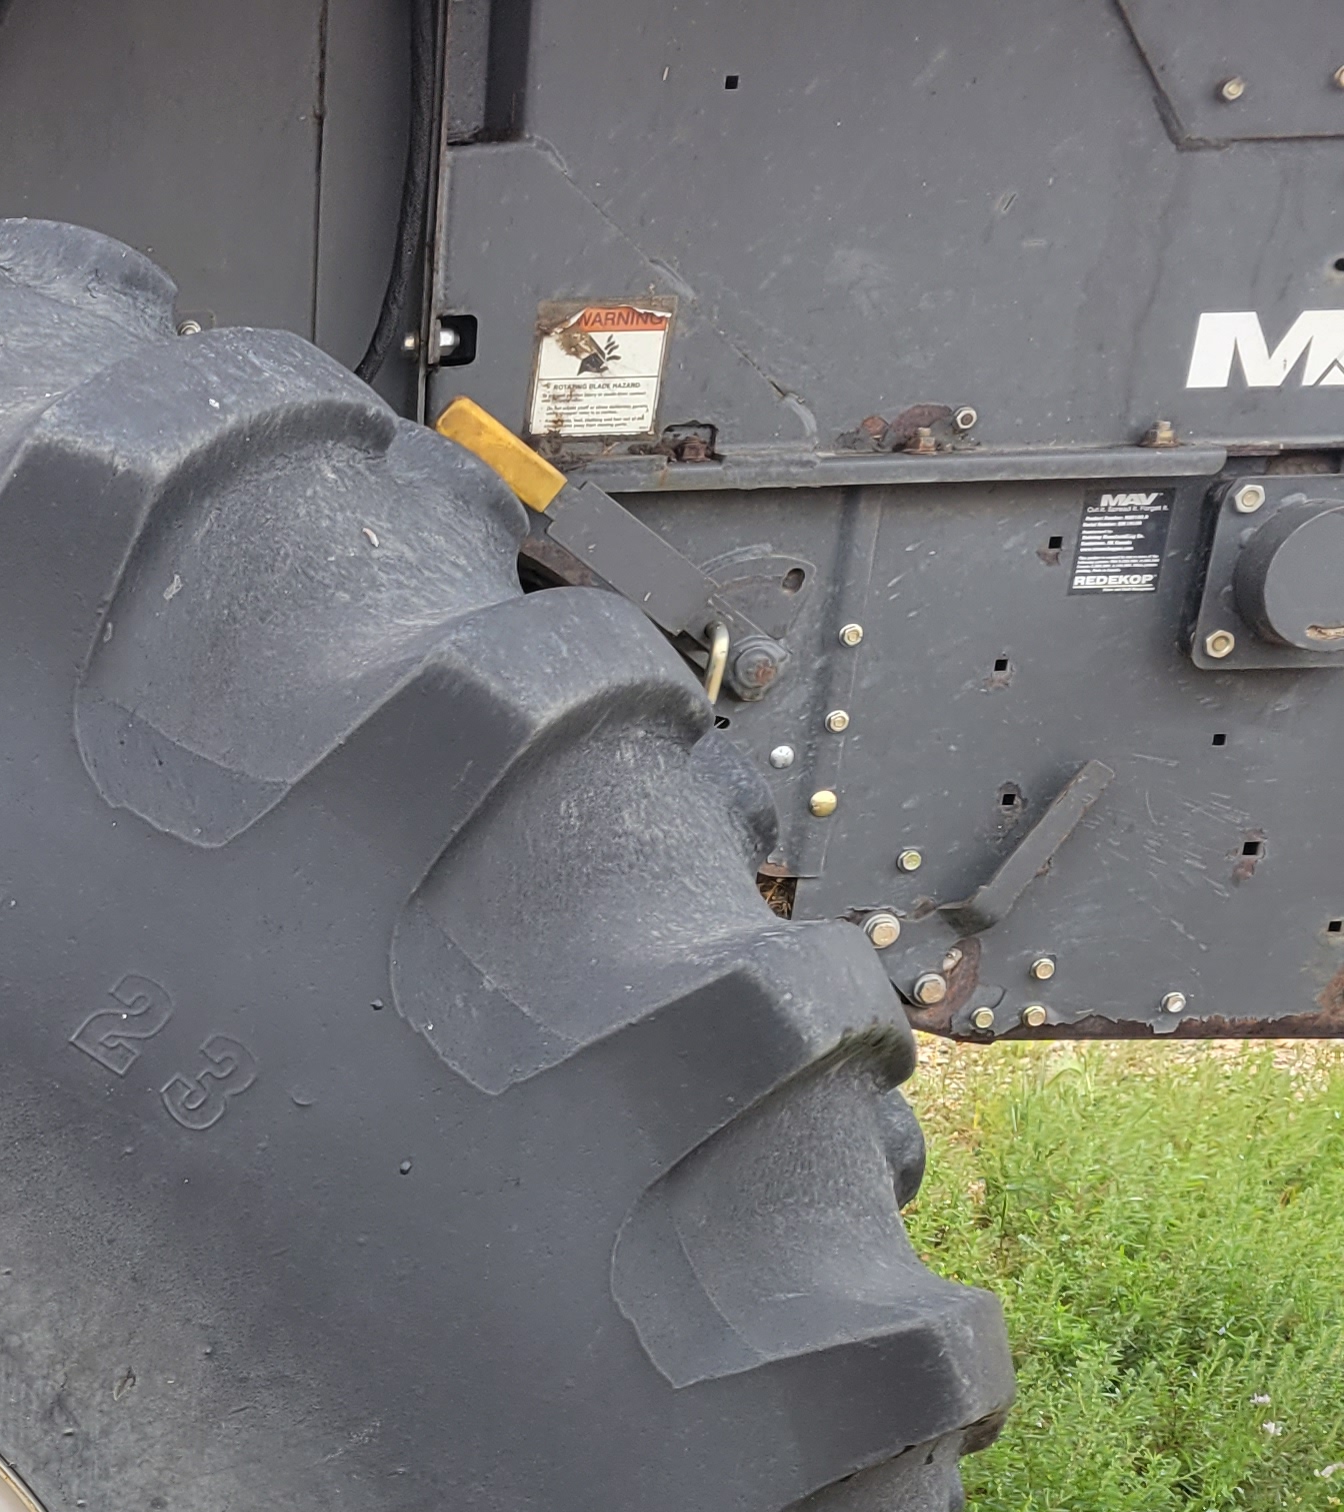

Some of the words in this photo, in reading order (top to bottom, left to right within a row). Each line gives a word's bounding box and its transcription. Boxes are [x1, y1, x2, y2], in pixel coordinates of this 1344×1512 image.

[577, 310, 664, 327] WARNING
[1100, 492, 1159, 507] MAV
[1073, 574, 1154, 586] REDEKOP
[69, 973, 258, 1131] 23
